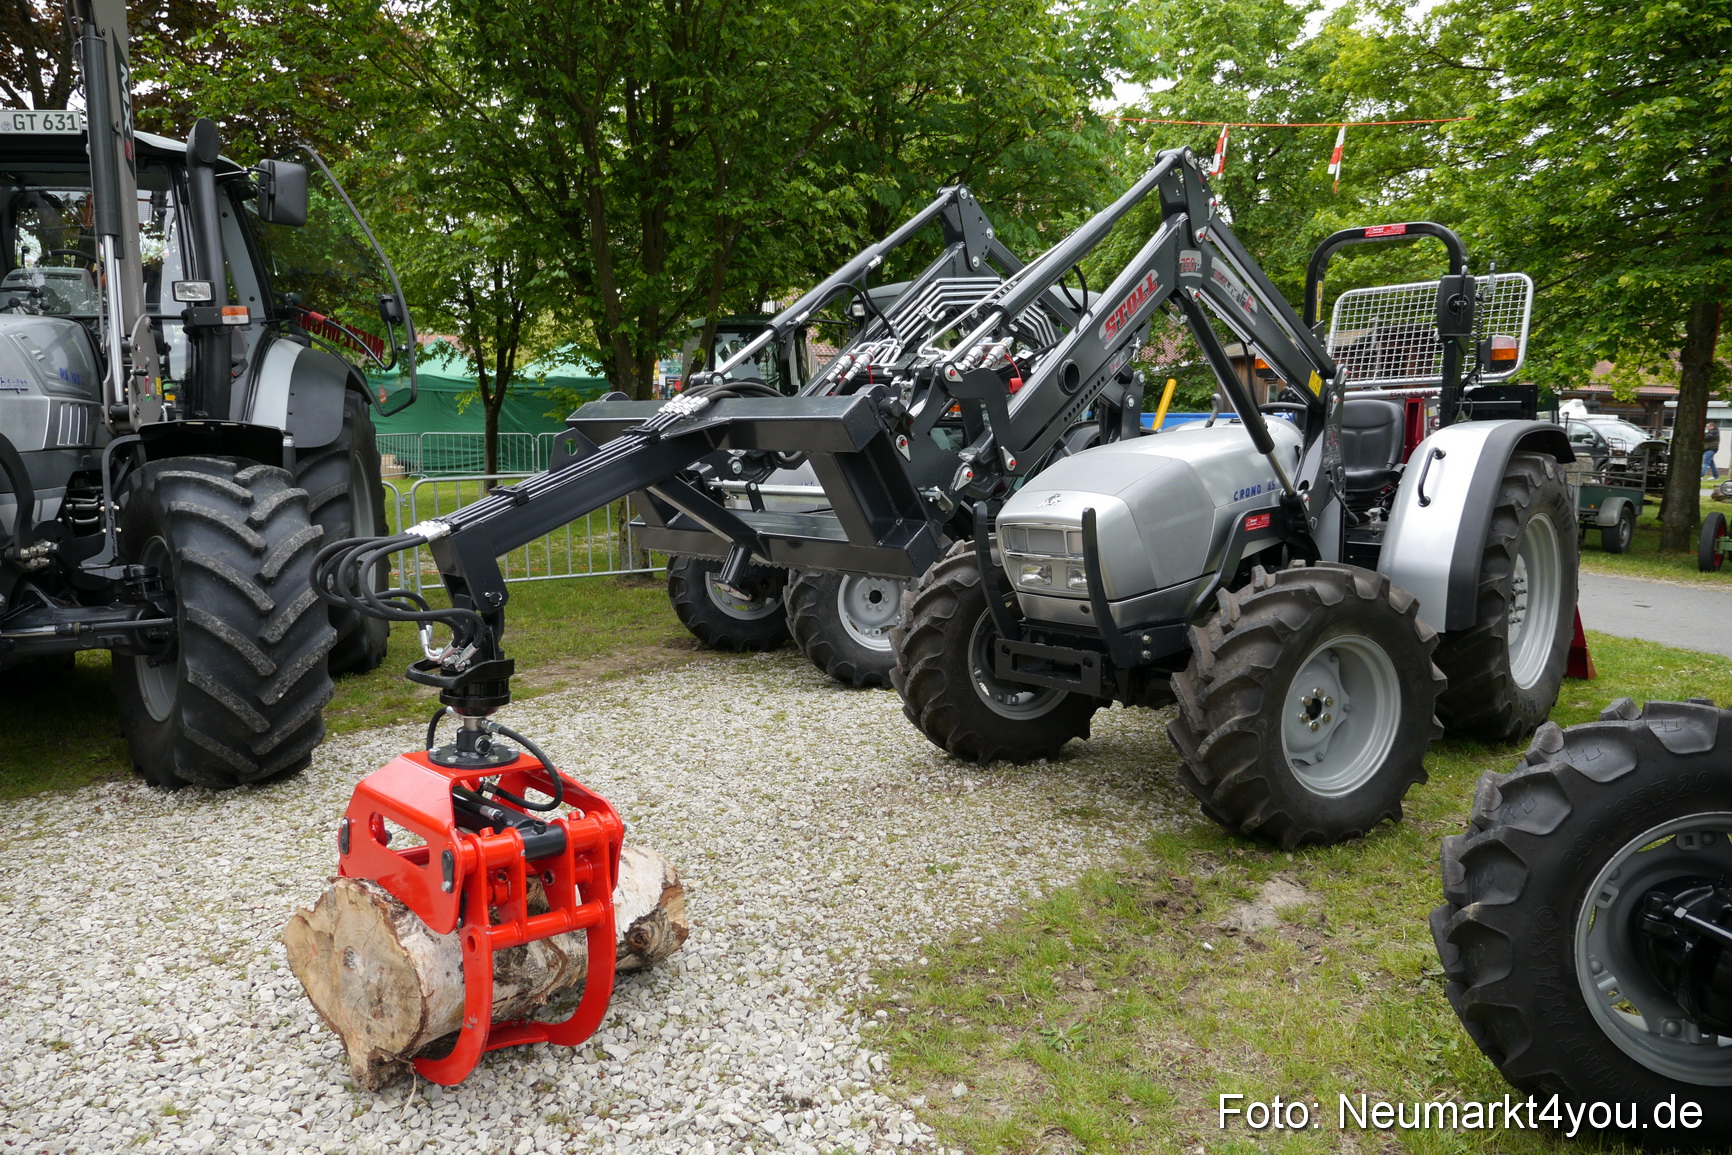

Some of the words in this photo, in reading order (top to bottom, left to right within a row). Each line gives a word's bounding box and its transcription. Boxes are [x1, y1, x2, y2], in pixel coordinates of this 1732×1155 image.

[13, 113, 38, 131] GT
[43, 113, 79, 131] 631
[119, 62, 133, 139] MX
[1104, 273, 1158, 342] STOLL
